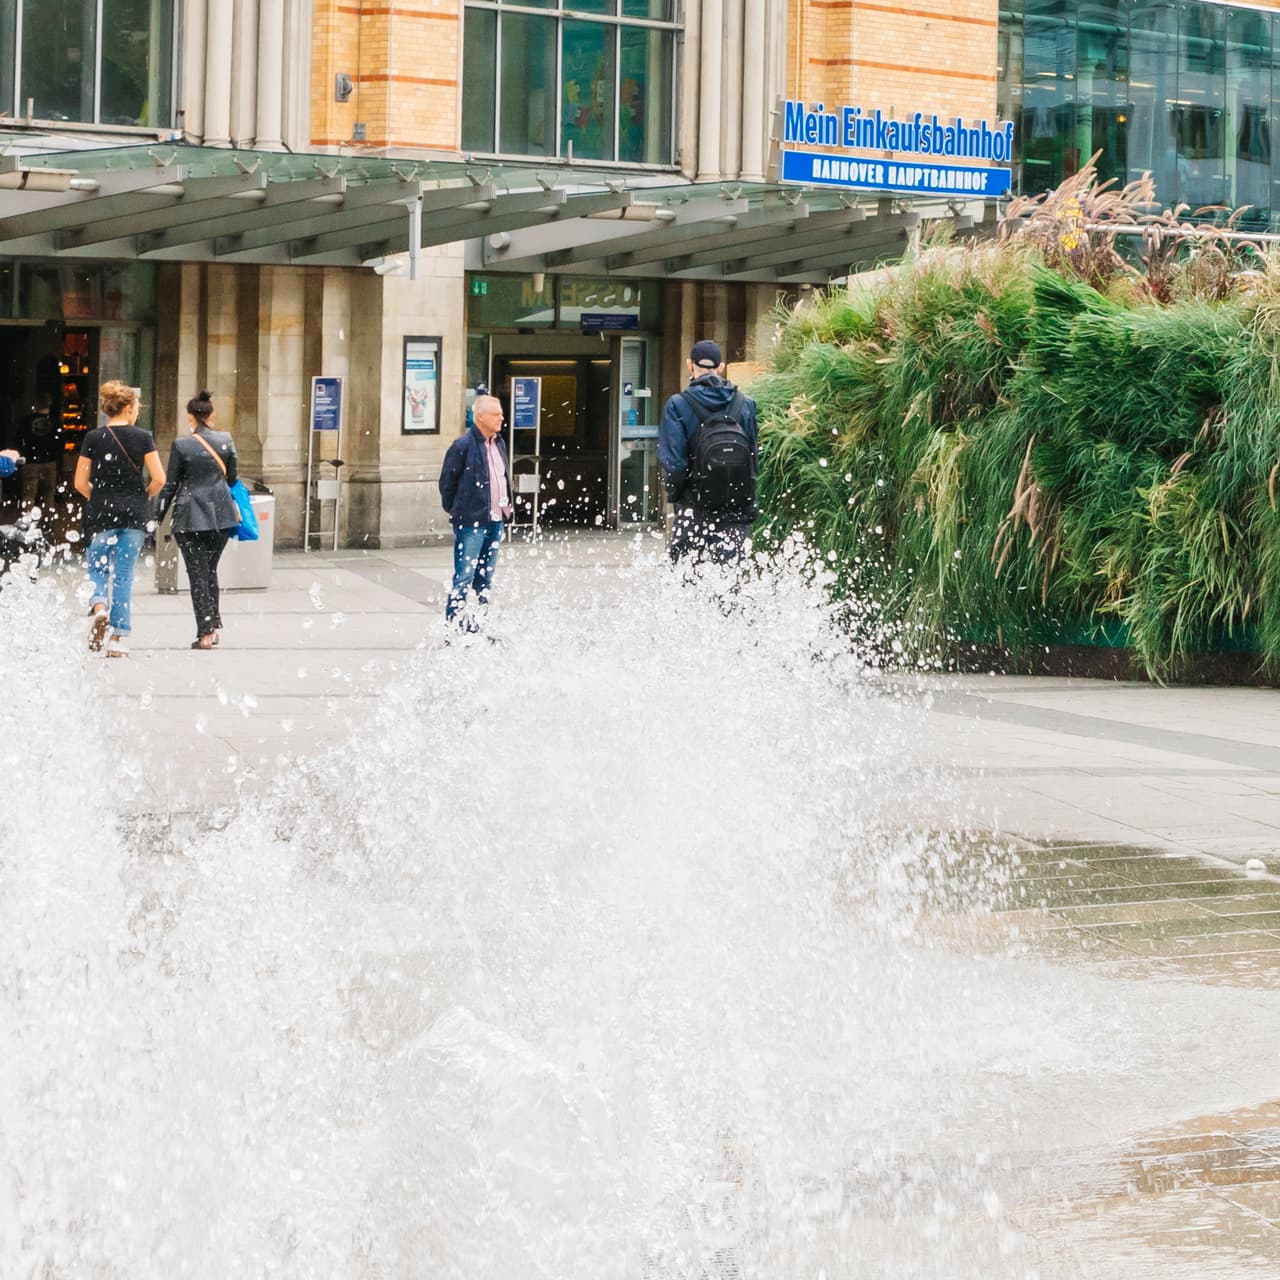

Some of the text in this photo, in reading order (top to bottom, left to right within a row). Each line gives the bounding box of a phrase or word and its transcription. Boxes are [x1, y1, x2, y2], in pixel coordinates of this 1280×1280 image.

[784, 100, 1014, 161] Mein Einkaufsbahnhof
[813, 158, 988, 191] HANNOVER HAUPTBAHNHOF
